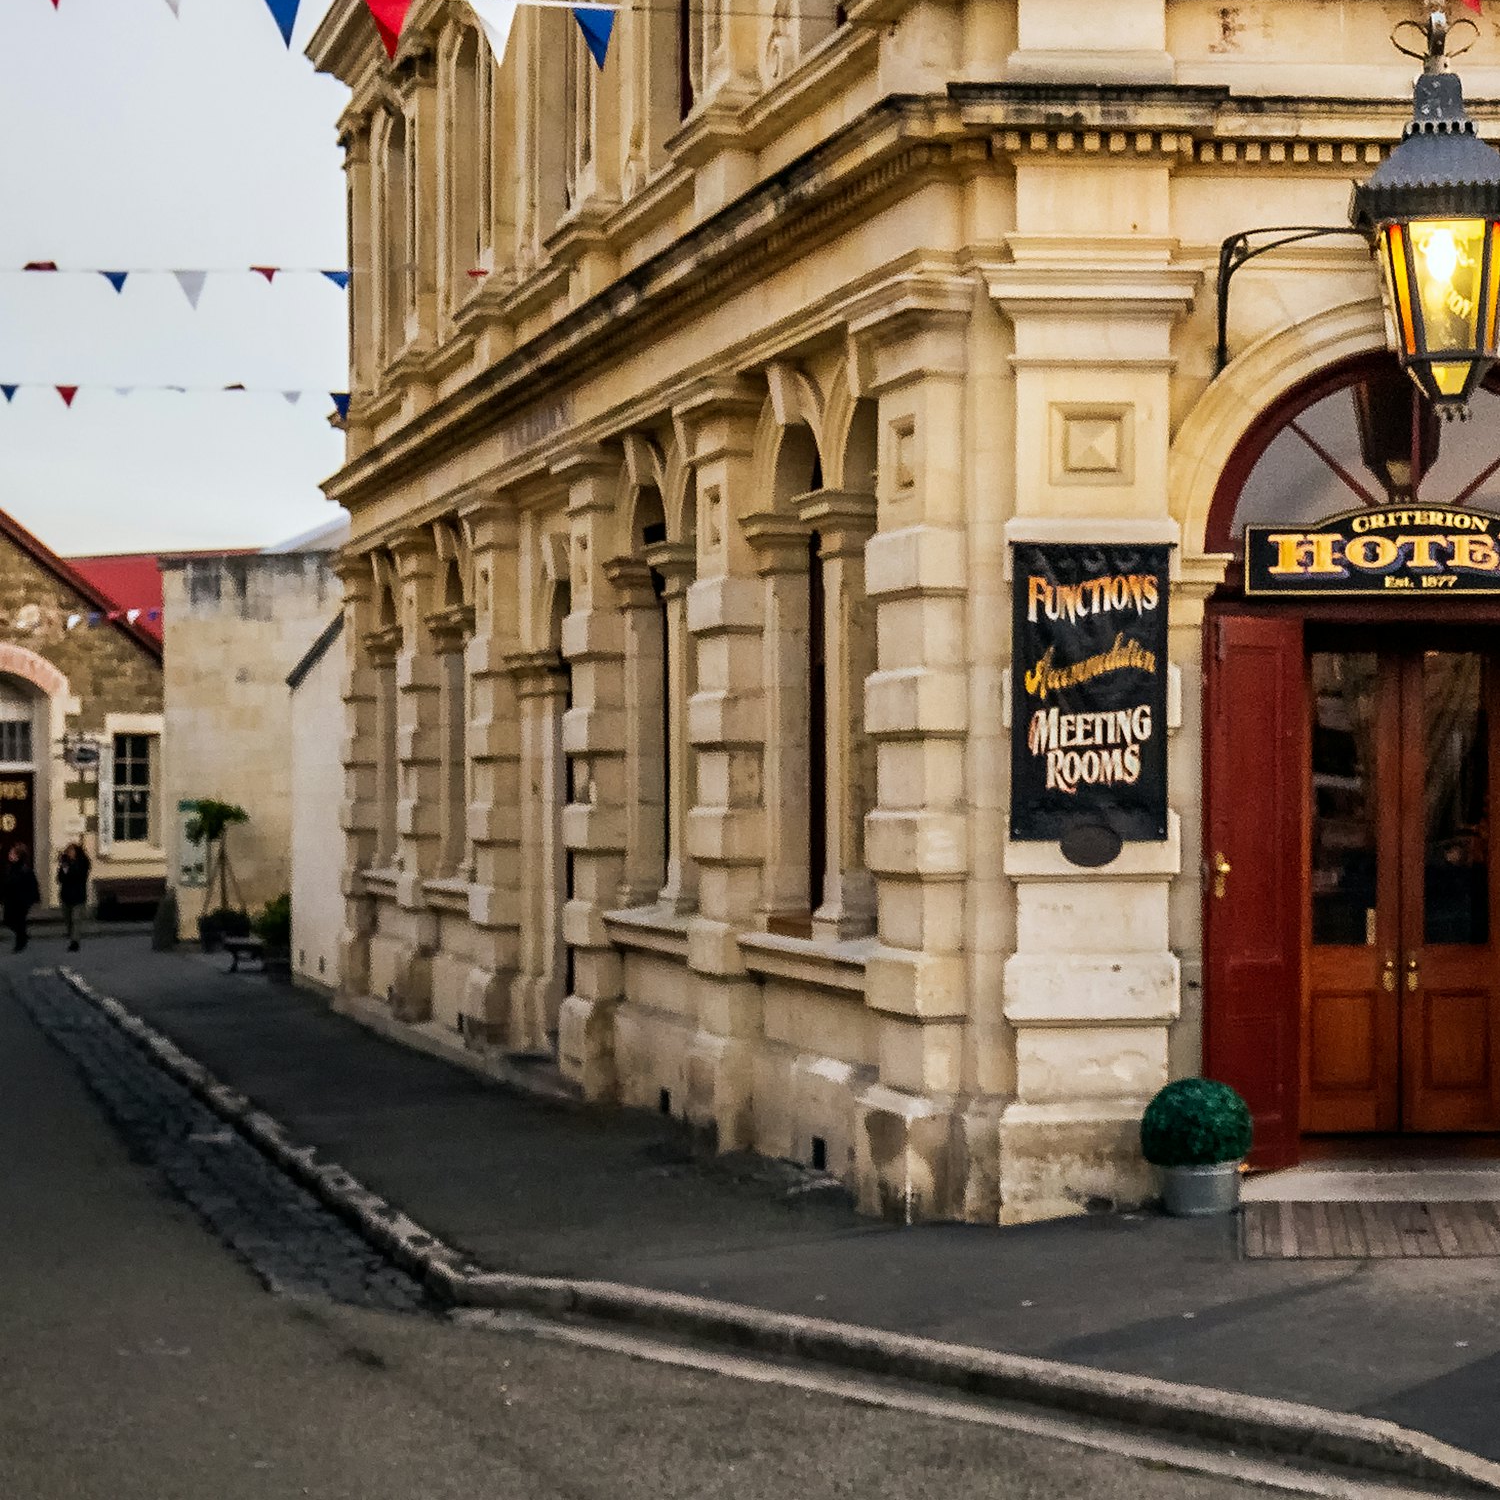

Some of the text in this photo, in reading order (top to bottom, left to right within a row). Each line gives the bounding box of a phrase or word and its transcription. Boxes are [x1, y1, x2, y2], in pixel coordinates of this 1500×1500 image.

[1352, 510, 1489, 533] CRITERION
[1027, 575, 1160, 624] FUNCTIONS
[1029, 706, 1153, 756] MEETING
[1045, 745, 1142, 794] ROOMS
